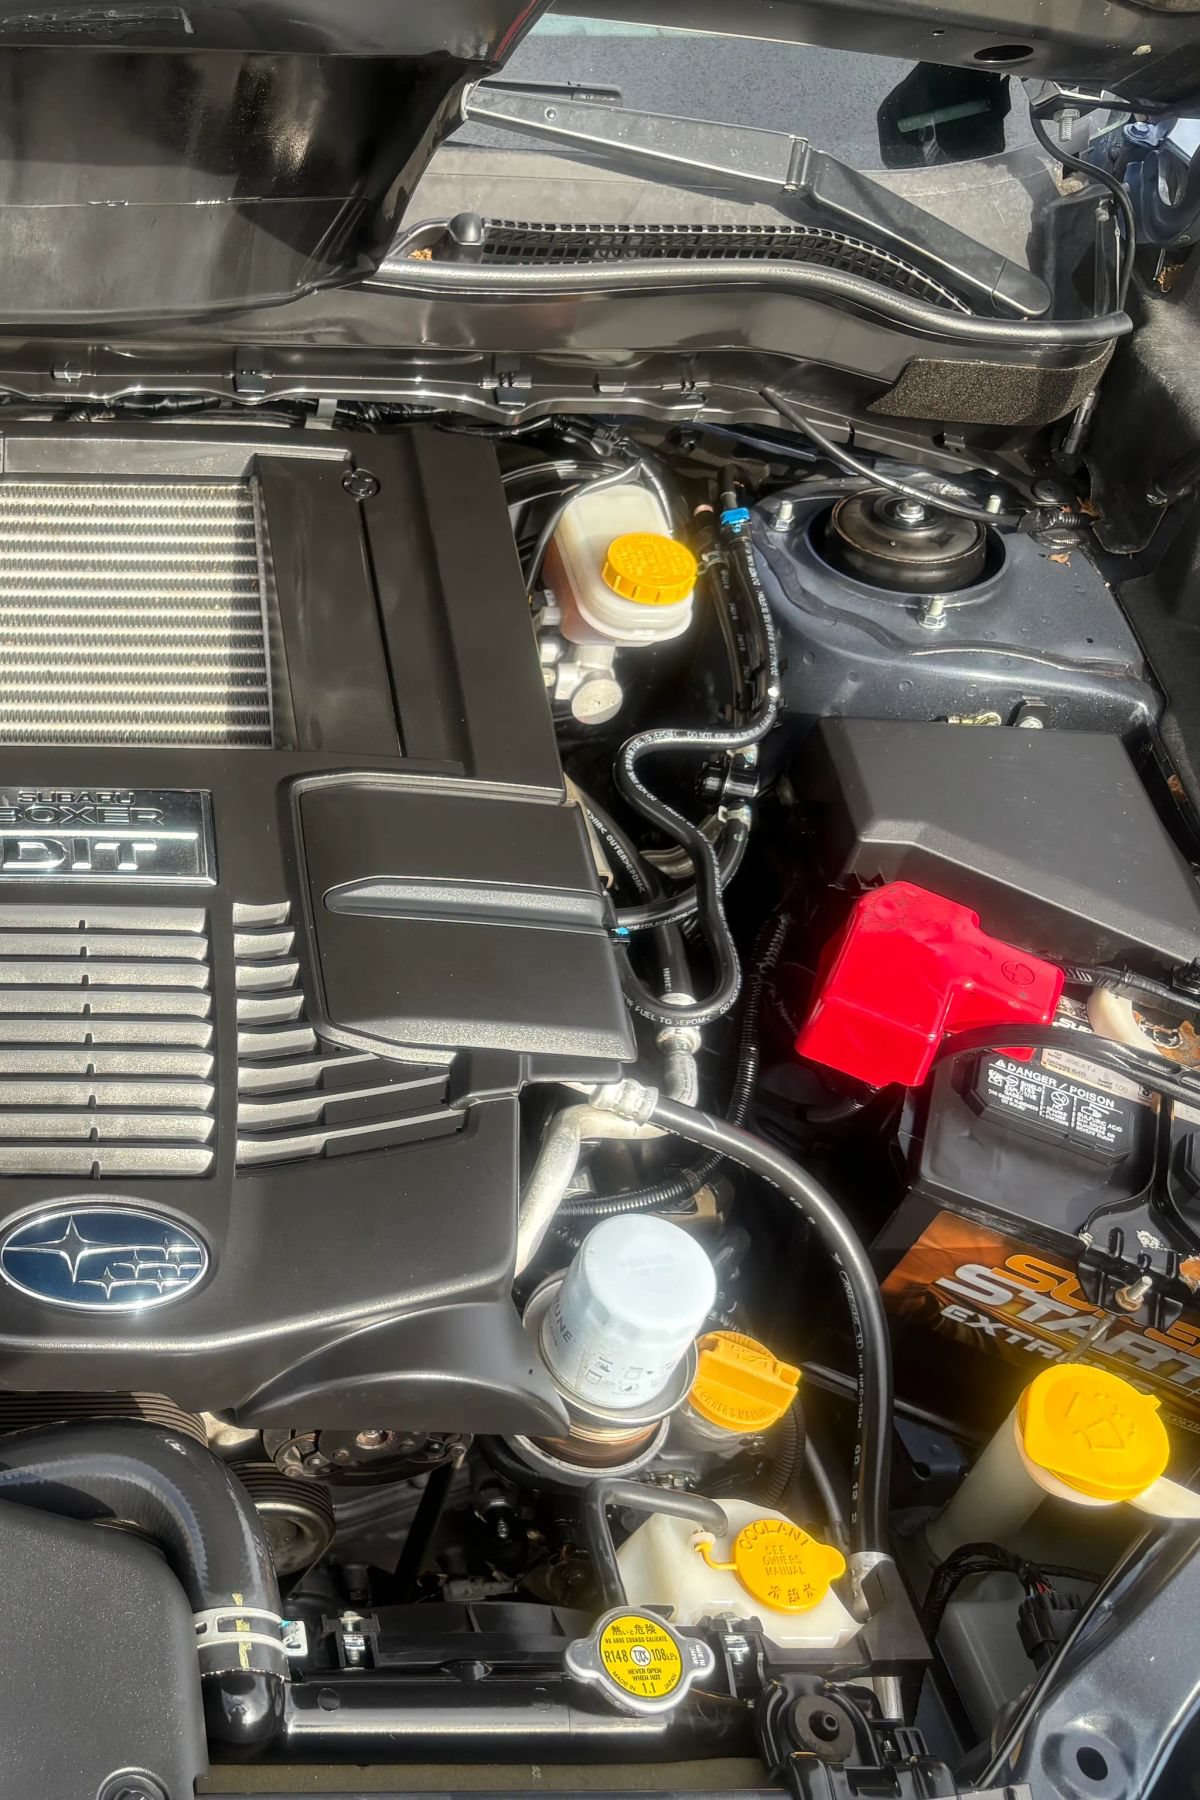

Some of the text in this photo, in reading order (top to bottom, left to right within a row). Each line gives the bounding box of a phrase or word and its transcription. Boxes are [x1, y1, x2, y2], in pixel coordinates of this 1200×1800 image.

[17, 791, 135, 805] SUBARU
[3, 838, 157, 870] DIT
[634, 1006, 657, 1021] FUEL
[719, 1002, 732, 1015] DO
[1007, 1062, 1057, 1087] DANGER
[1070, 1085, 1115, 1108] POISON
[1107, 1123, 1123, 1133] ACID
[738, 1521, 812, 1549] COOLANT
[766, 1545, 786, 1555] SEE
[604, 1650, 628, 1663] R148
[613, 1671, 628, 1688] MADE
[664, 1673, 677, 1690] JAPAN
[642, 1682, 656, 1694] 1.1
